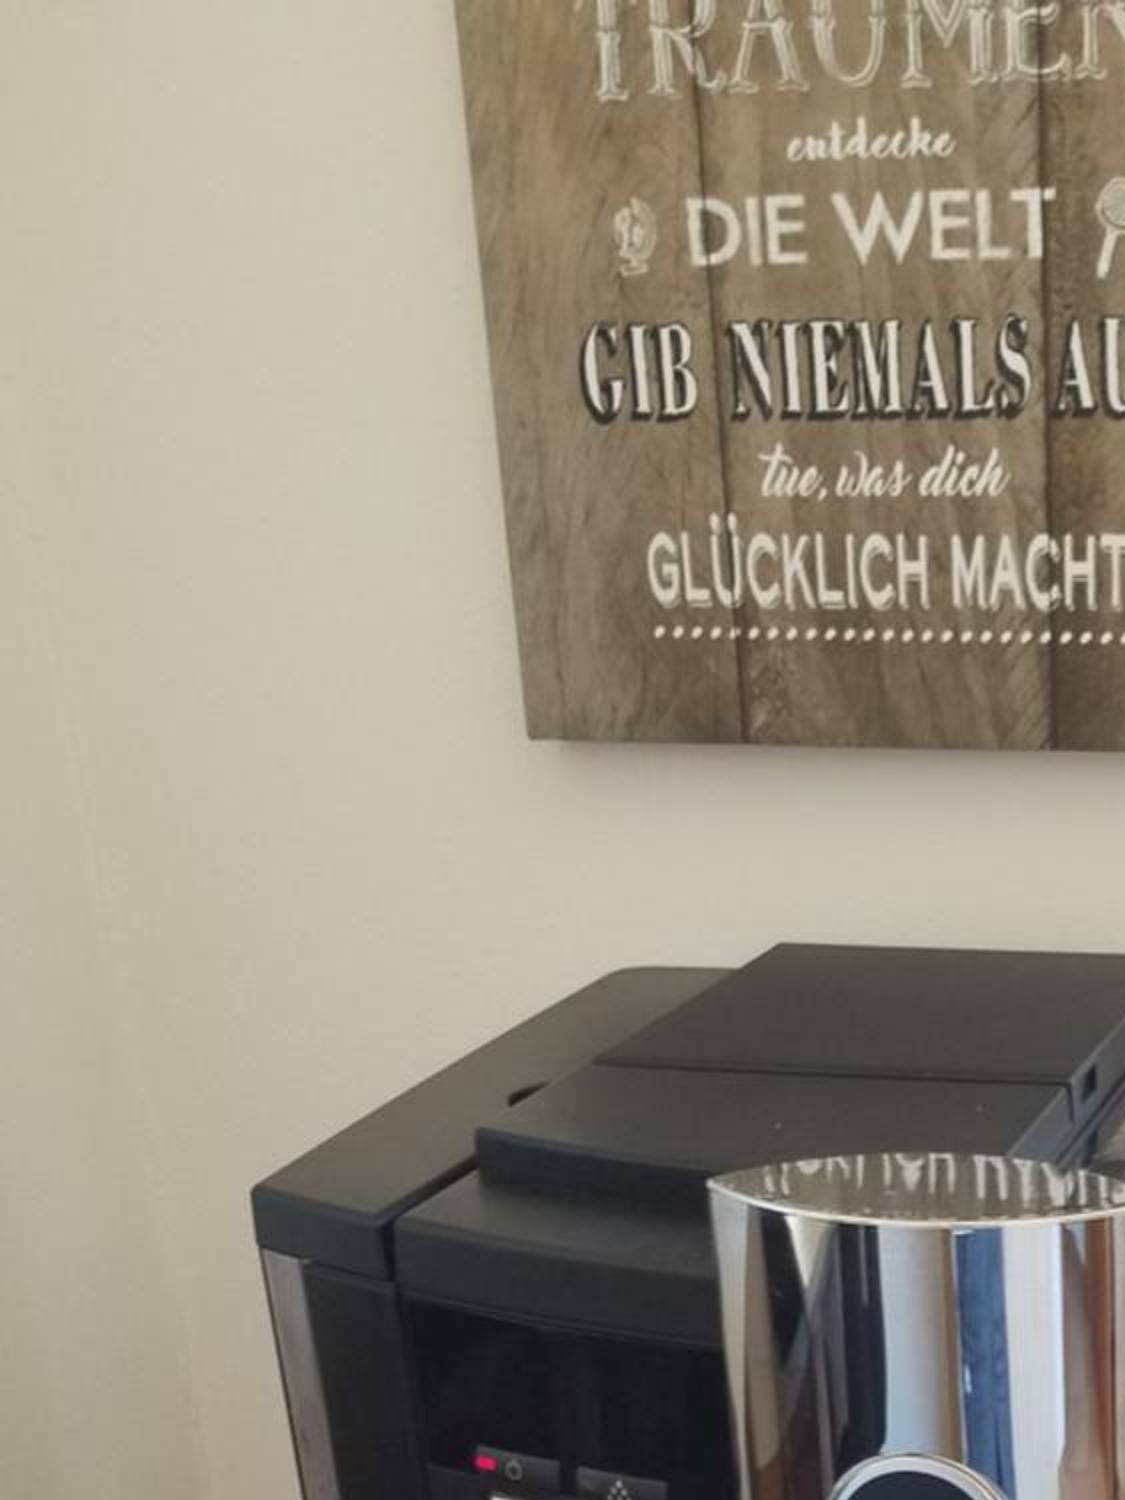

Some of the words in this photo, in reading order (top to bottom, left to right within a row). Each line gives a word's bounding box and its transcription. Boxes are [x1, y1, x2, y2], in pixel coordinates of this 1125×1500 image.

[787, 116, 956, 161] entdecke
[685, 193, 809, 267] DIE
[831, 187, 1056, 265] WELT
[580, 321, 699, 423] GIB
[728, 315, 1033, 422] NIEMALS
[836, 453, 913, 498] was
[920, 443, 1012, 499] dich
[647, 511, 930, 611] GLÜCKLICH
